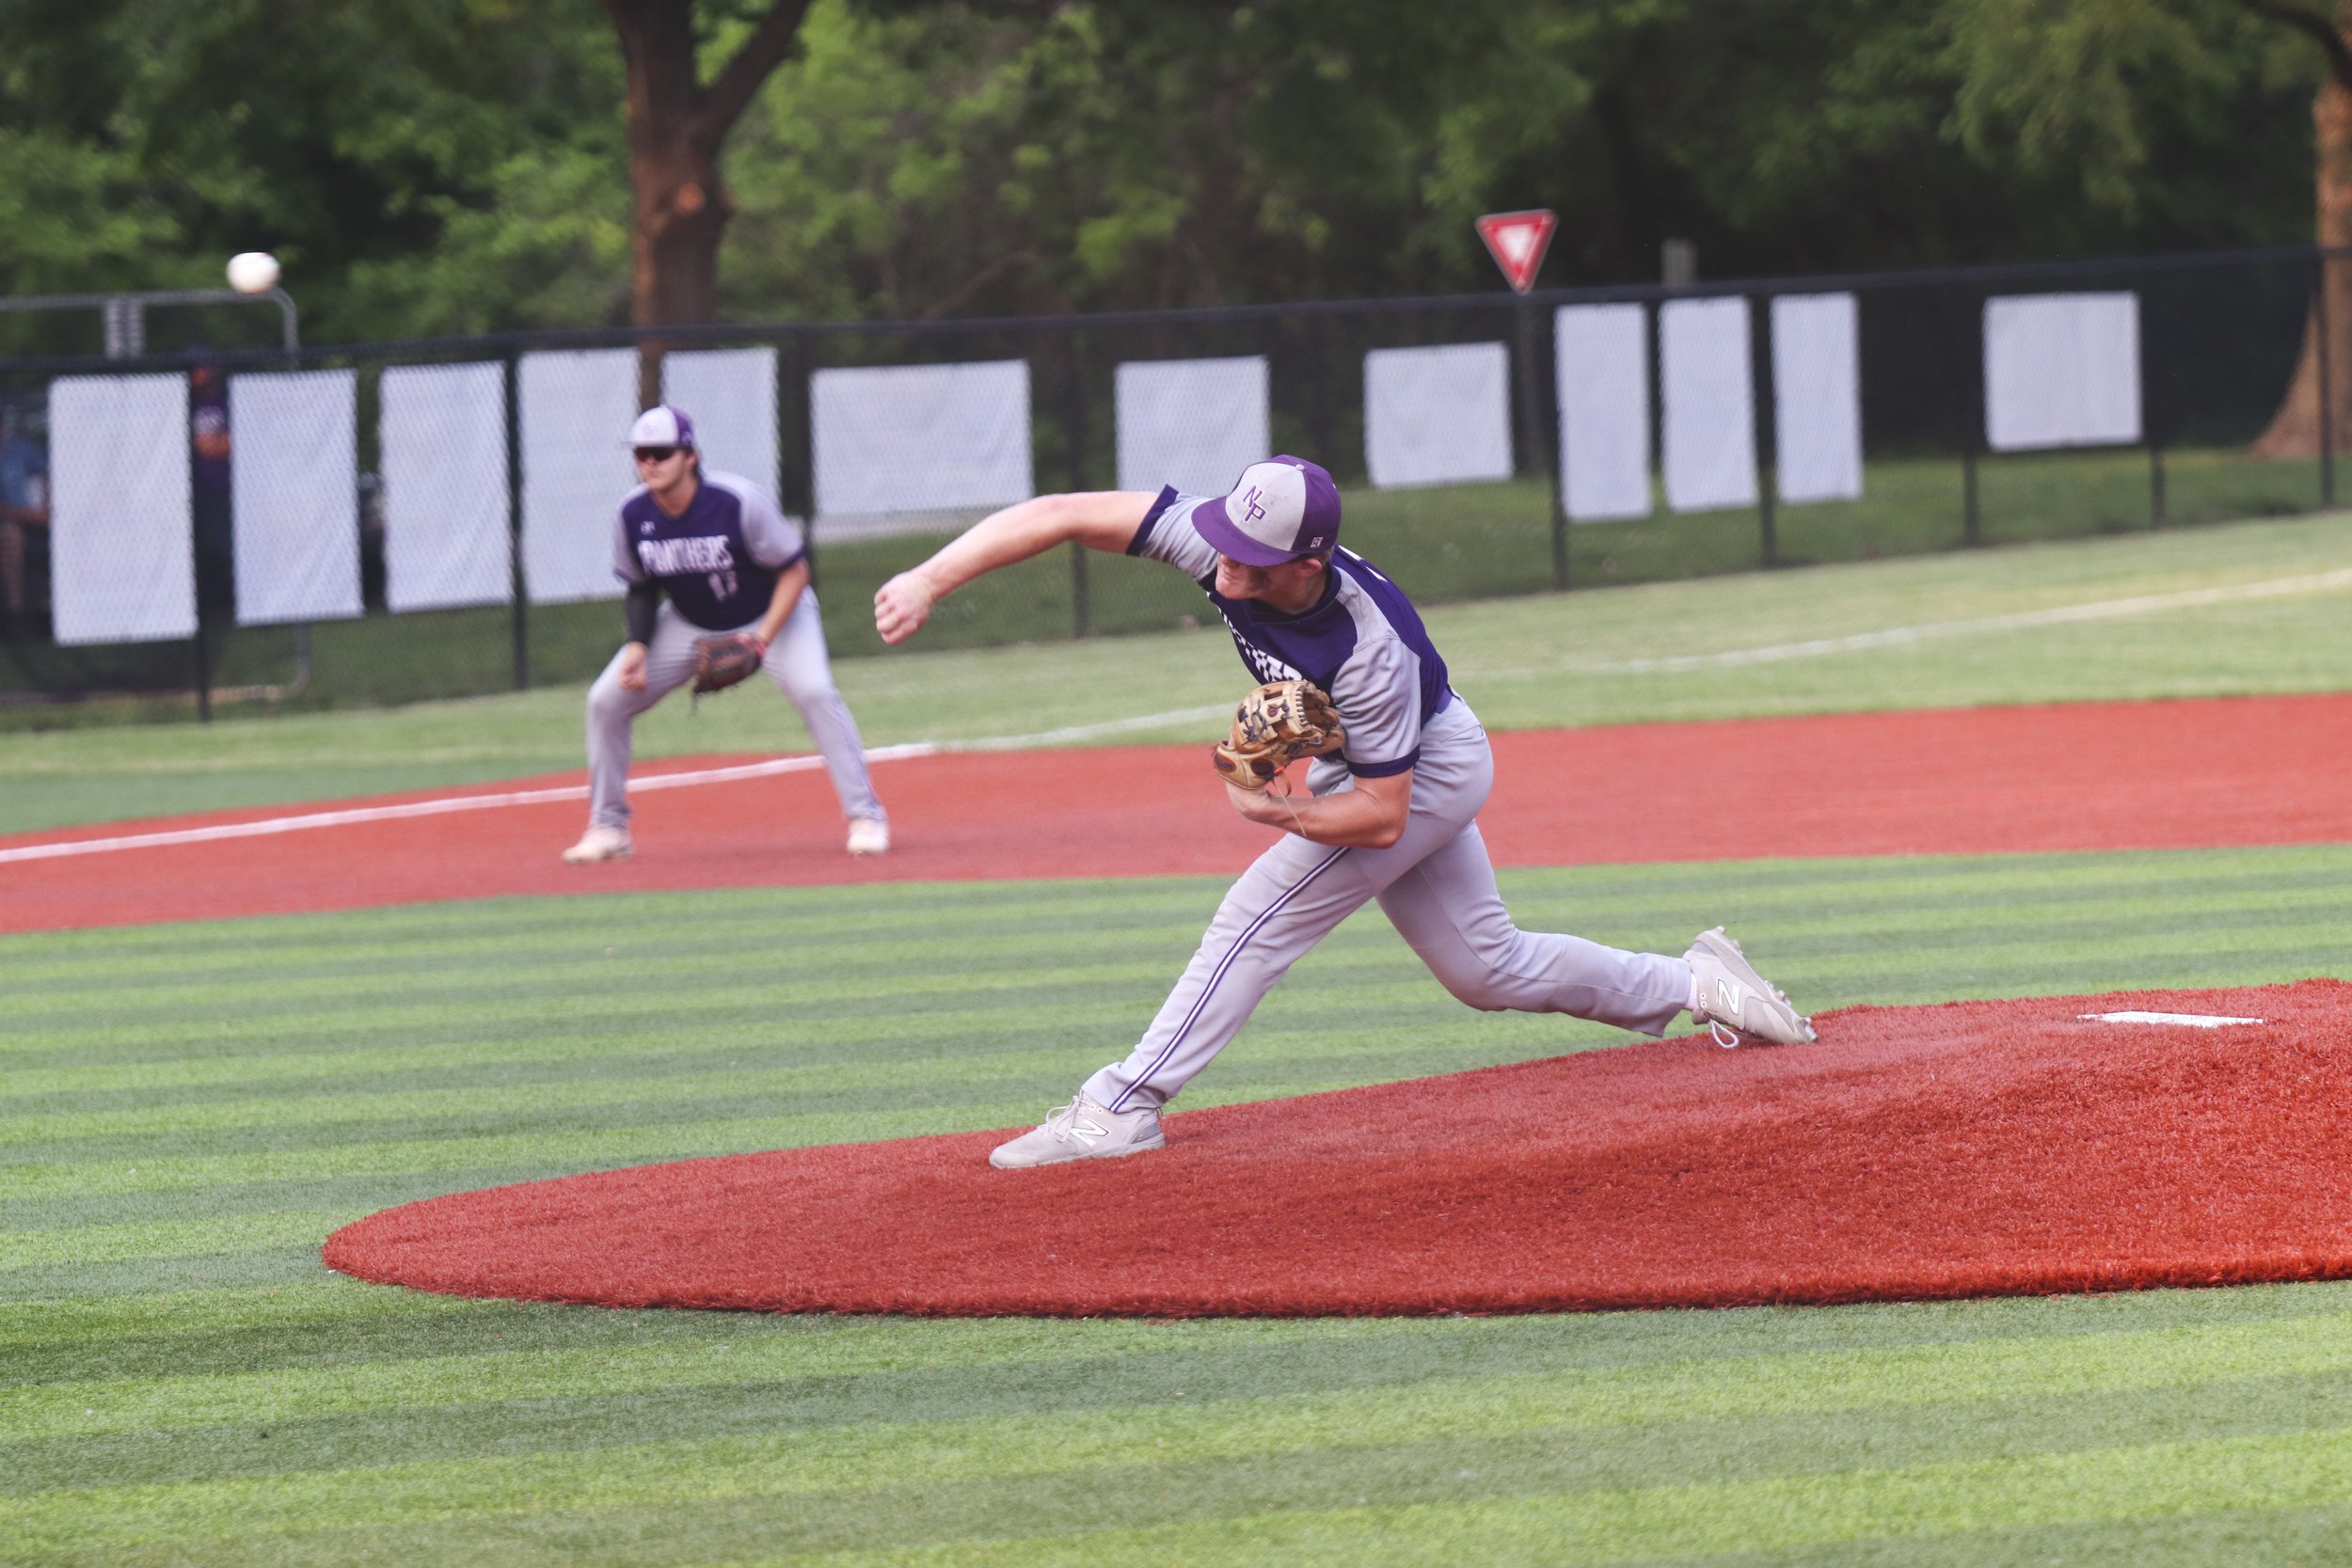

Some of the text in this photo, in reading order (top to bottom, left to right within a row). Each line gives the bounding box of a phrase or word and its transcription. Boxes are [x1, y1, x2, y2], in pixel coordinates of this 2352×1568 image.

[638, 535, 734, 576] PANTHERS
[1717, 978, 1740, 1015] N
[1069, 1117, 1110, 1147] N
